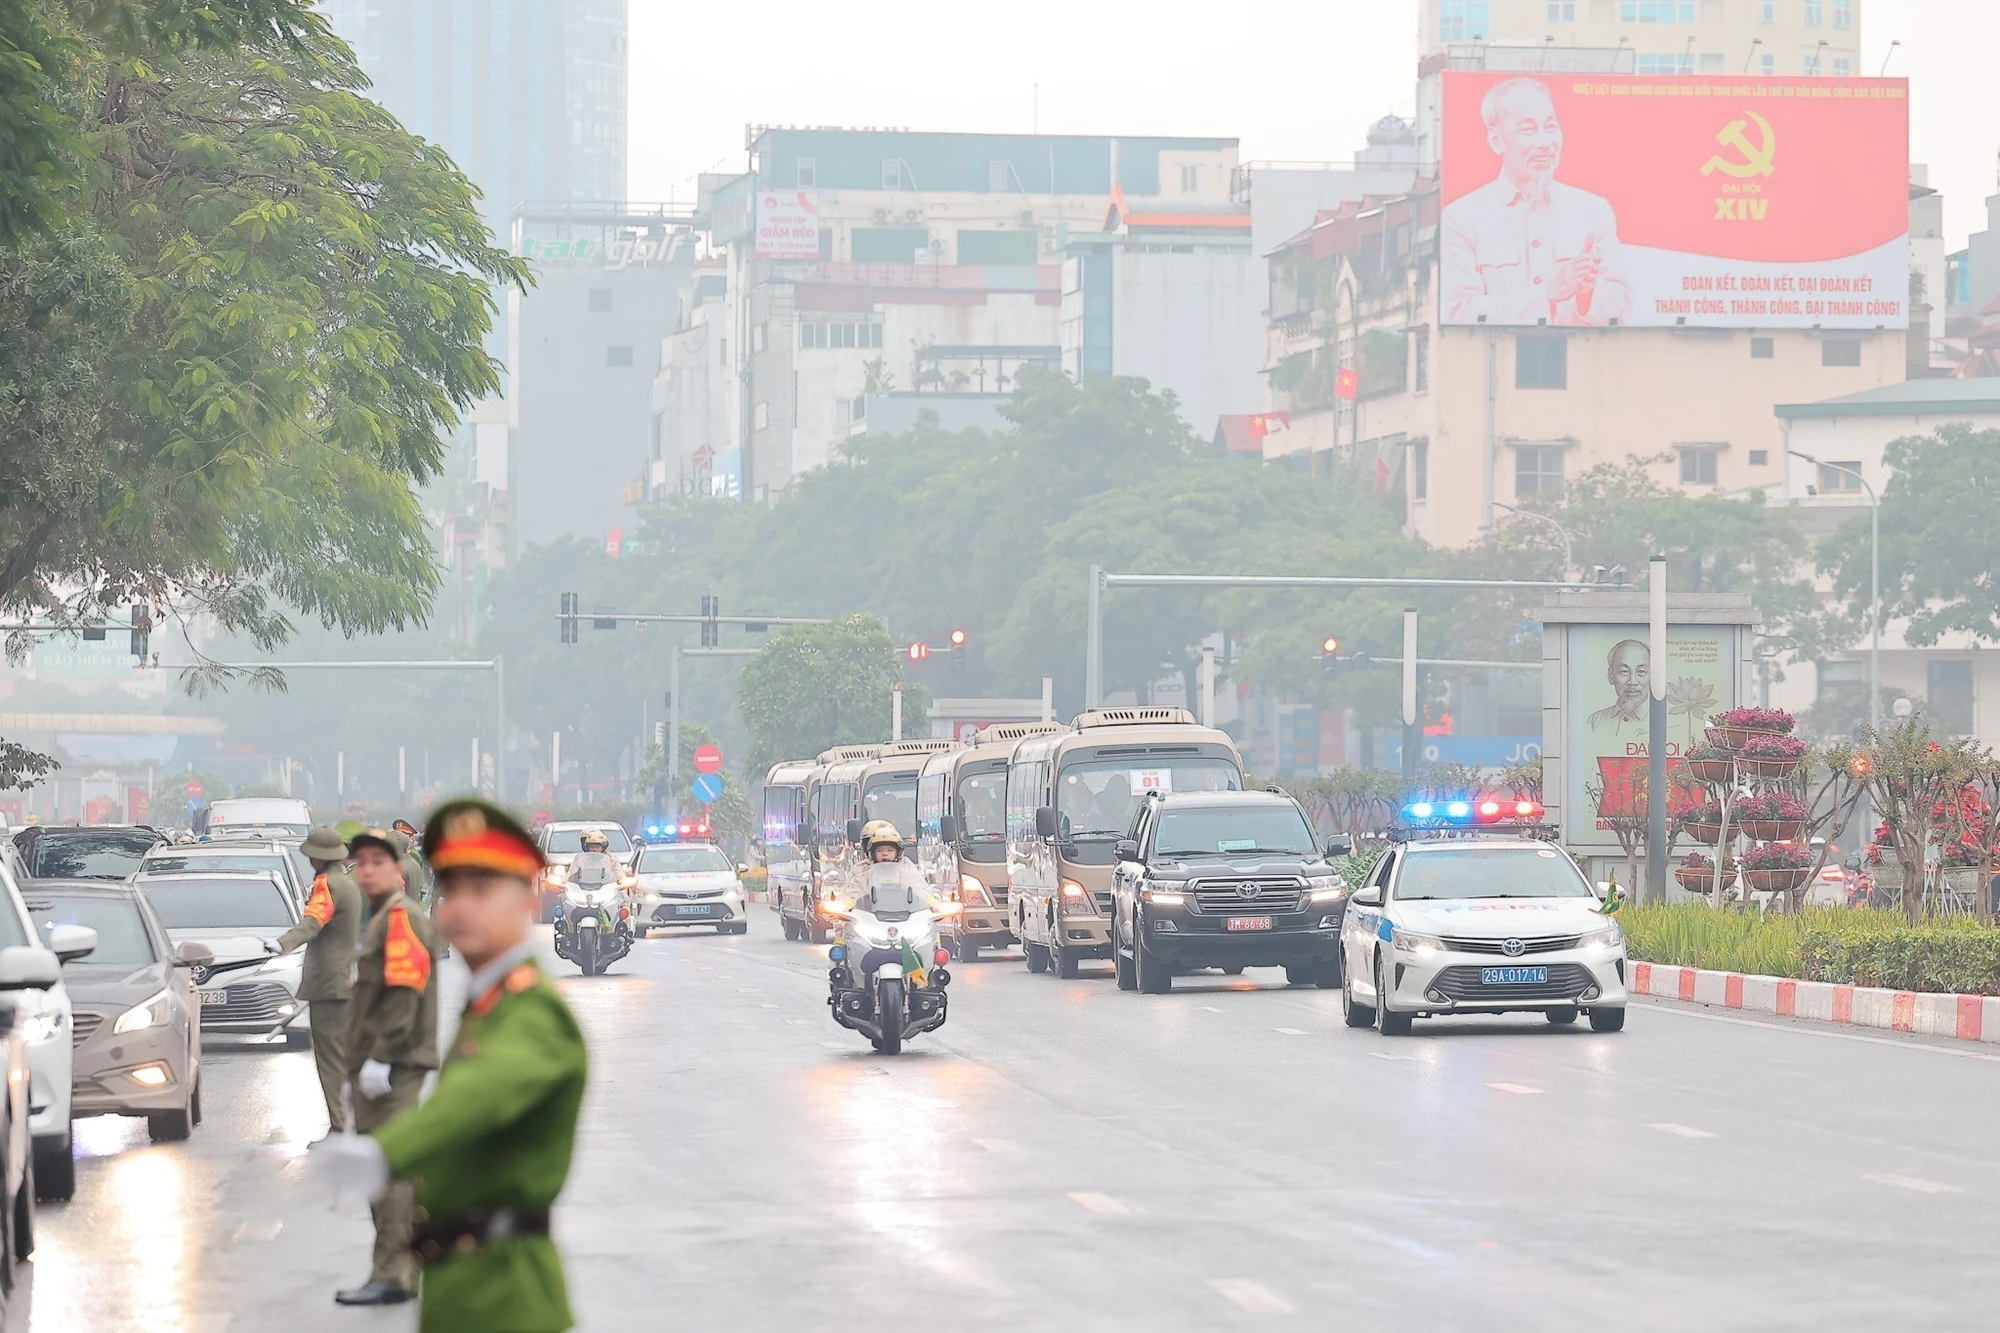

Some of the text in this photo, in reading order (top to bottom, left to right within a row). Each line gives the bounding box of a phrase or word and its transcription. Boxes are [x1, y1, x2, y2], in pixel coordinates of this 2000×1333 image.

[1714, 197, 1769, 221] XIV
[522, 233, 686, 271] tat golf
[1682, 272, 1873, 294] ĐOÀN KẾT, ĐOÀN KẾT, ĐẠI ĐOÀN KẾT
[1655, 297, 1690, 313] THÀNH
[1731, 297, 1766, 314] THÀNH
[1806, 300, 1824, 318] ĐẠI
[1828, 298, 1862, 315] THÀNH
[1866, 298, 1900, 316] CÔNG!
[1142, 777, 1160, 788] 01
[1484, 969, 1545, 982] 29A-017.14
